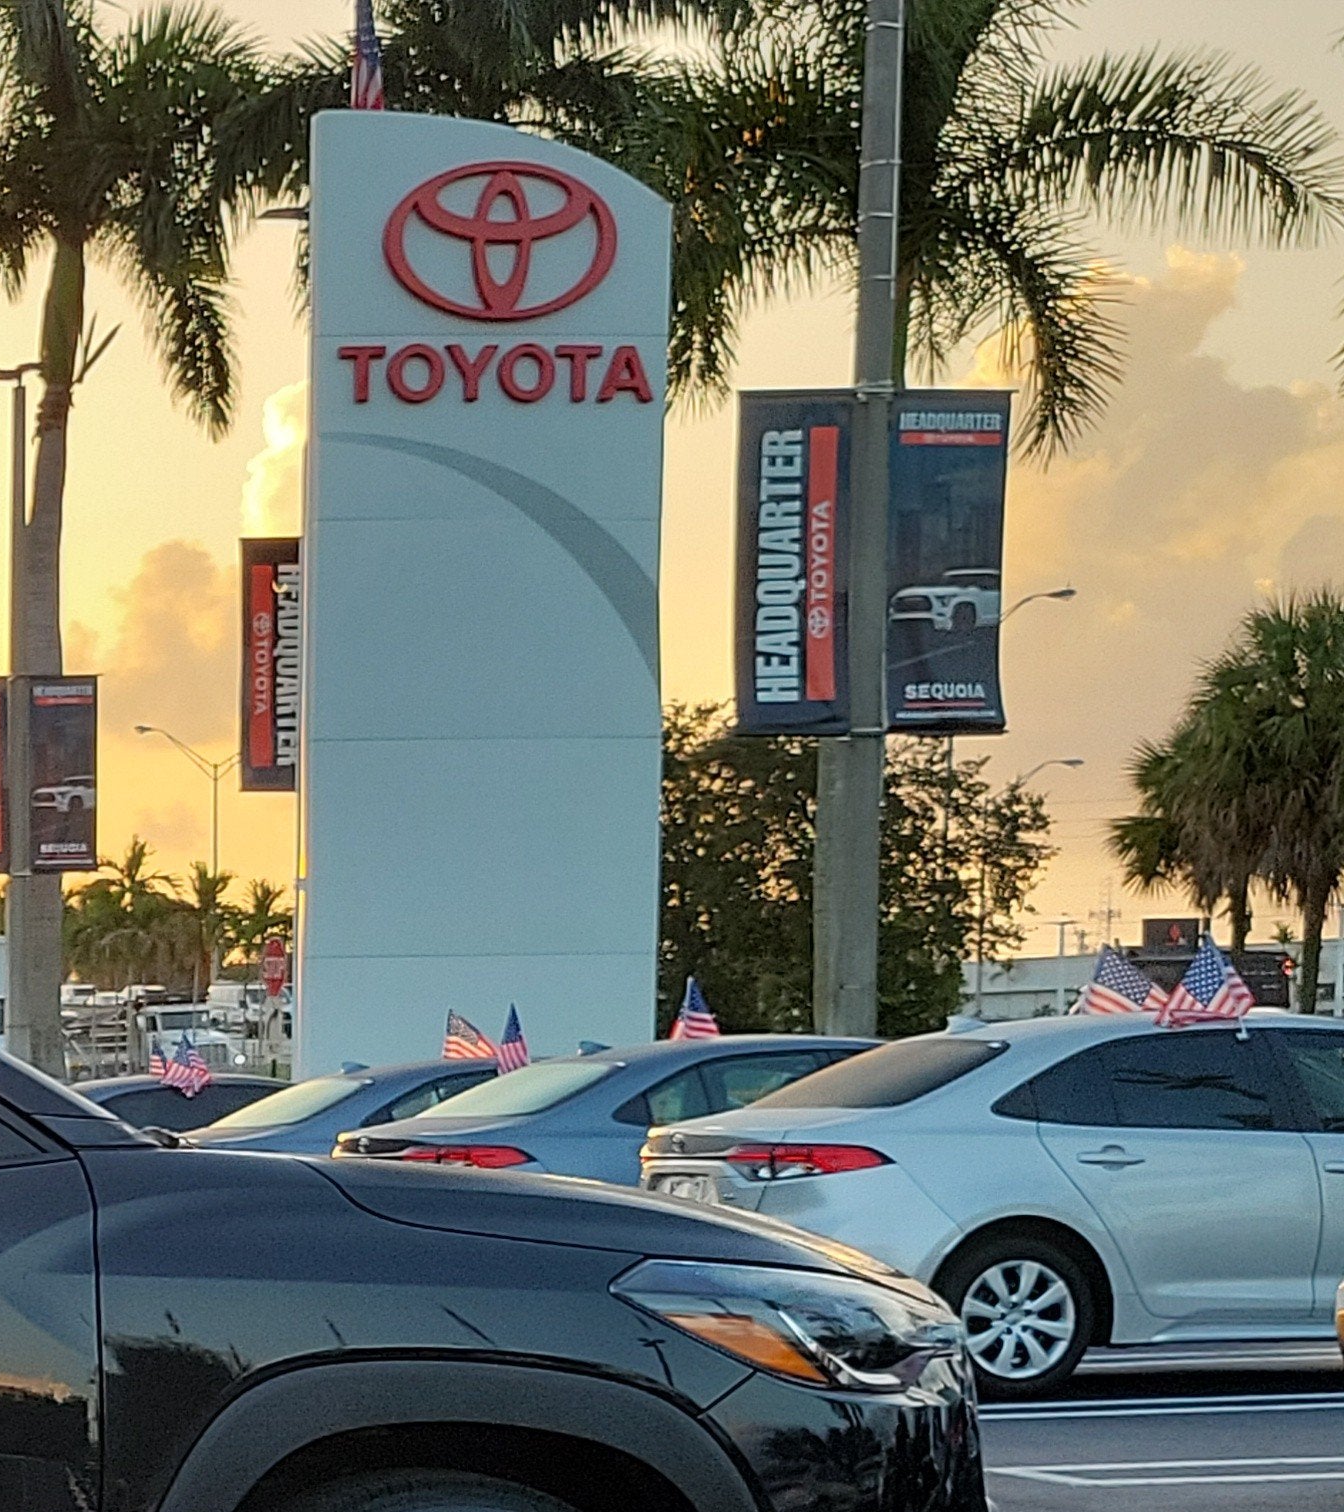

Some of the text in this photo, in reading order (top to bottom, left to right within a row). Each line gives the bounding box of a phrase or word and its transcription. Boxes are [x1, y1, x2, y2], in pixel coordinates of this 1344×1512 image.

[337, 343, 653, 404] TOYOTA
[899, 412, 1001, 432] HEADQUARTER
[755, 429, 805, 703] HEADQUARTER
[811, 500, 832, 602] TOYOTA
[254, 640, 271, 716] TOYOTA
[904, 682, 986, 700] SEQUOIA
